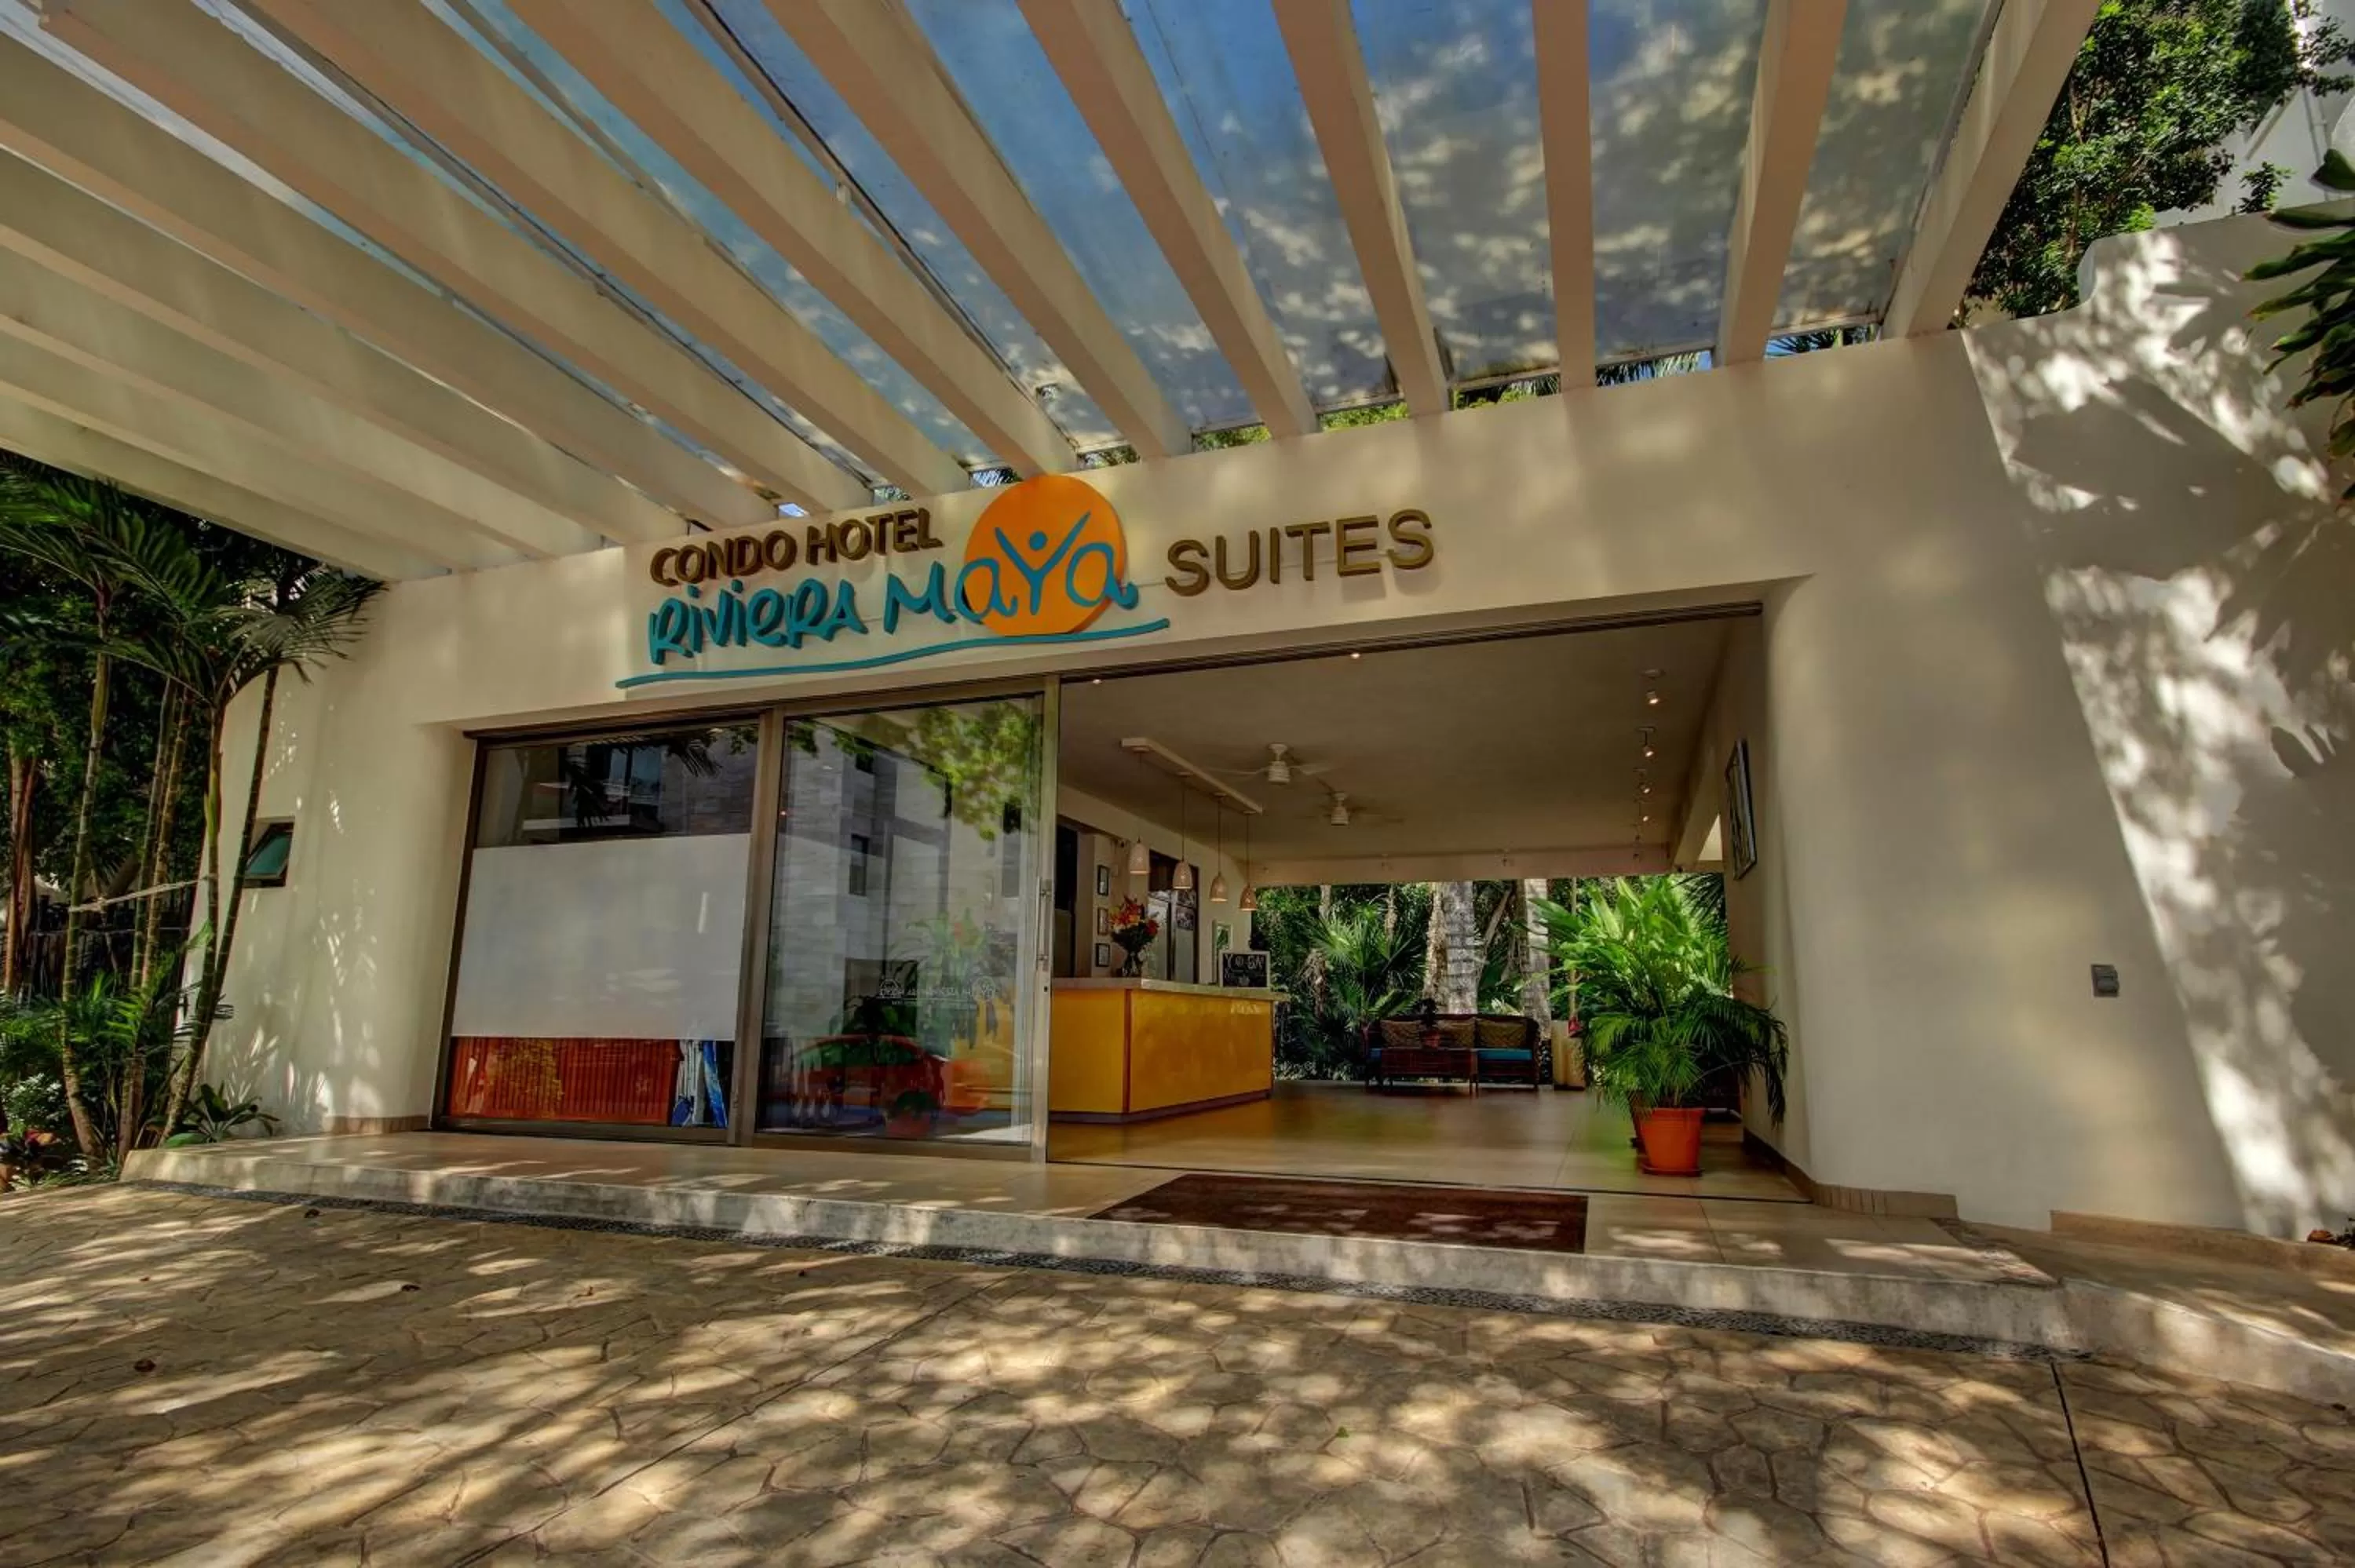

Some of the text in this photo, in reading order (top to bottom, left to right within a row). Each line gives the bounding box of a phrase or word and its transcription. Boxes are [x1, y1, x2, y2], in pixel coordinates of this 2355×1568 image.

[649, 508, 944, 587] CONDO HOTEL
[1164, 509, 1434, 597] SUITES
